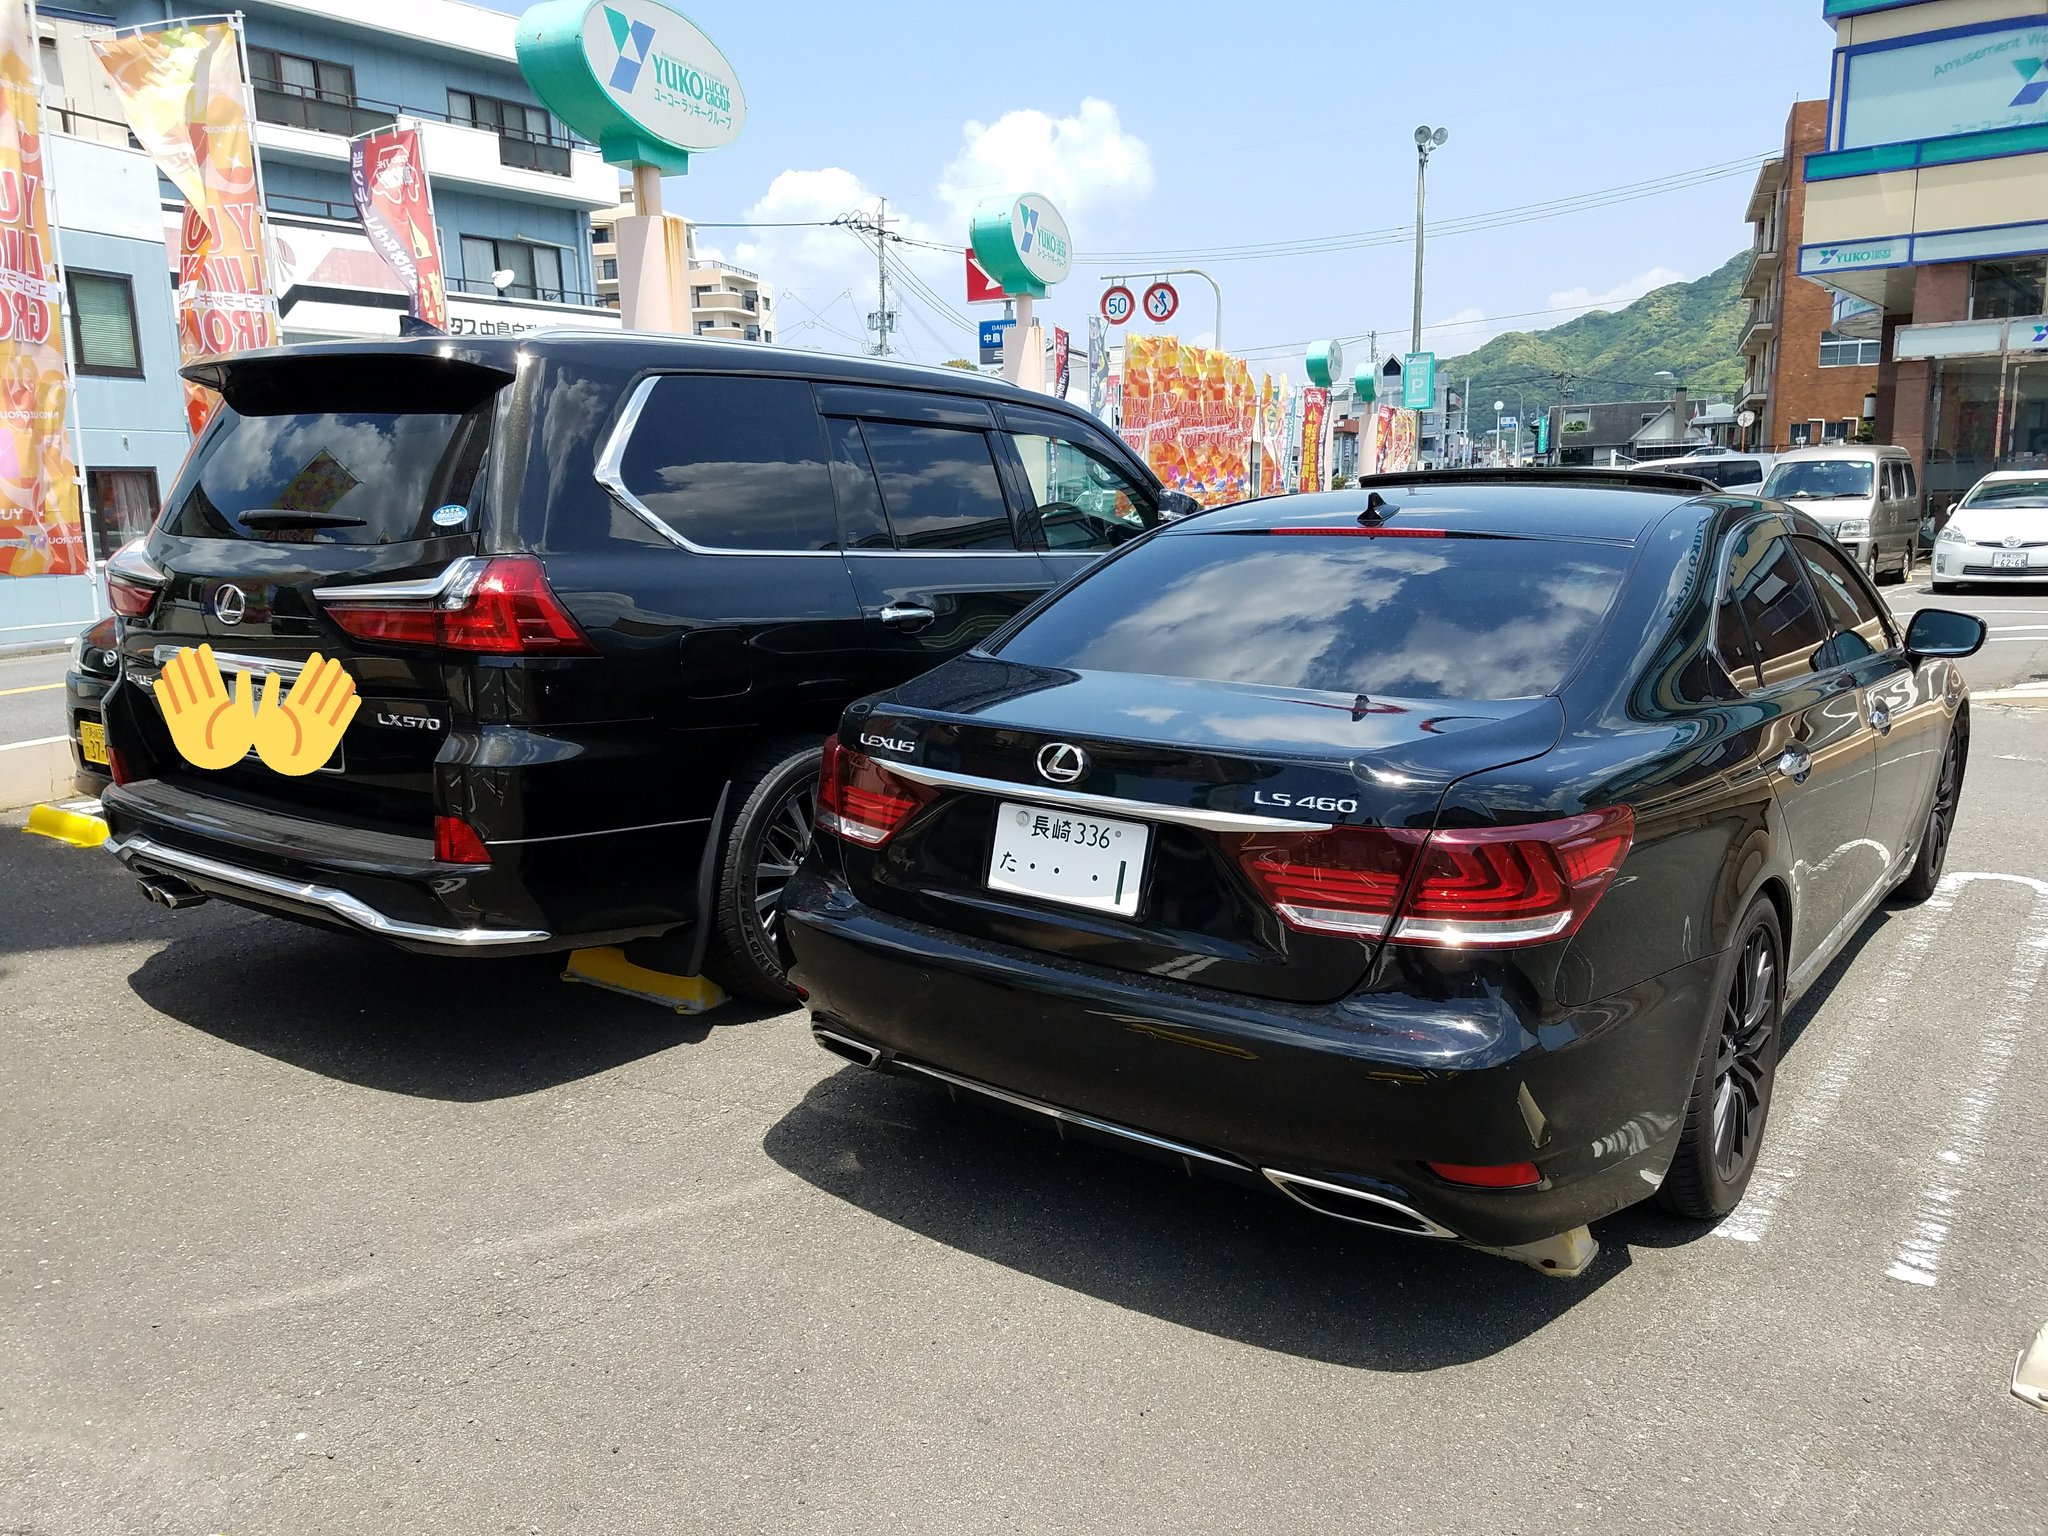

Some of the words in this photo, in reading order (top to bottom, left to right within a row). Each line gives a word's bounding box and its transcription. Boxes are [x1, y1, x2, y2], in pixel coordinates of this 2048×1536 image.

[651, 53, 704, 101] YUKO
[704, 76, 730, 100] LUCKY
[654, 87, 732, 130] ユーコーラッキーグループ
[704, 91, 731, 113] GROUP
[1037, 227, 1056, 253] YUKO
[1836, 251, 1871, 263] YUKO
[1108, 297, 1127, 315] 50
[1410, 378, 1425, 394] P
[2000, 558, 2026, 567] 62-68
[860, 732, 915, 753] LEXUS
[1253, 790, 1291, 807] LS
[1295, 796, 1358, 813] 460
